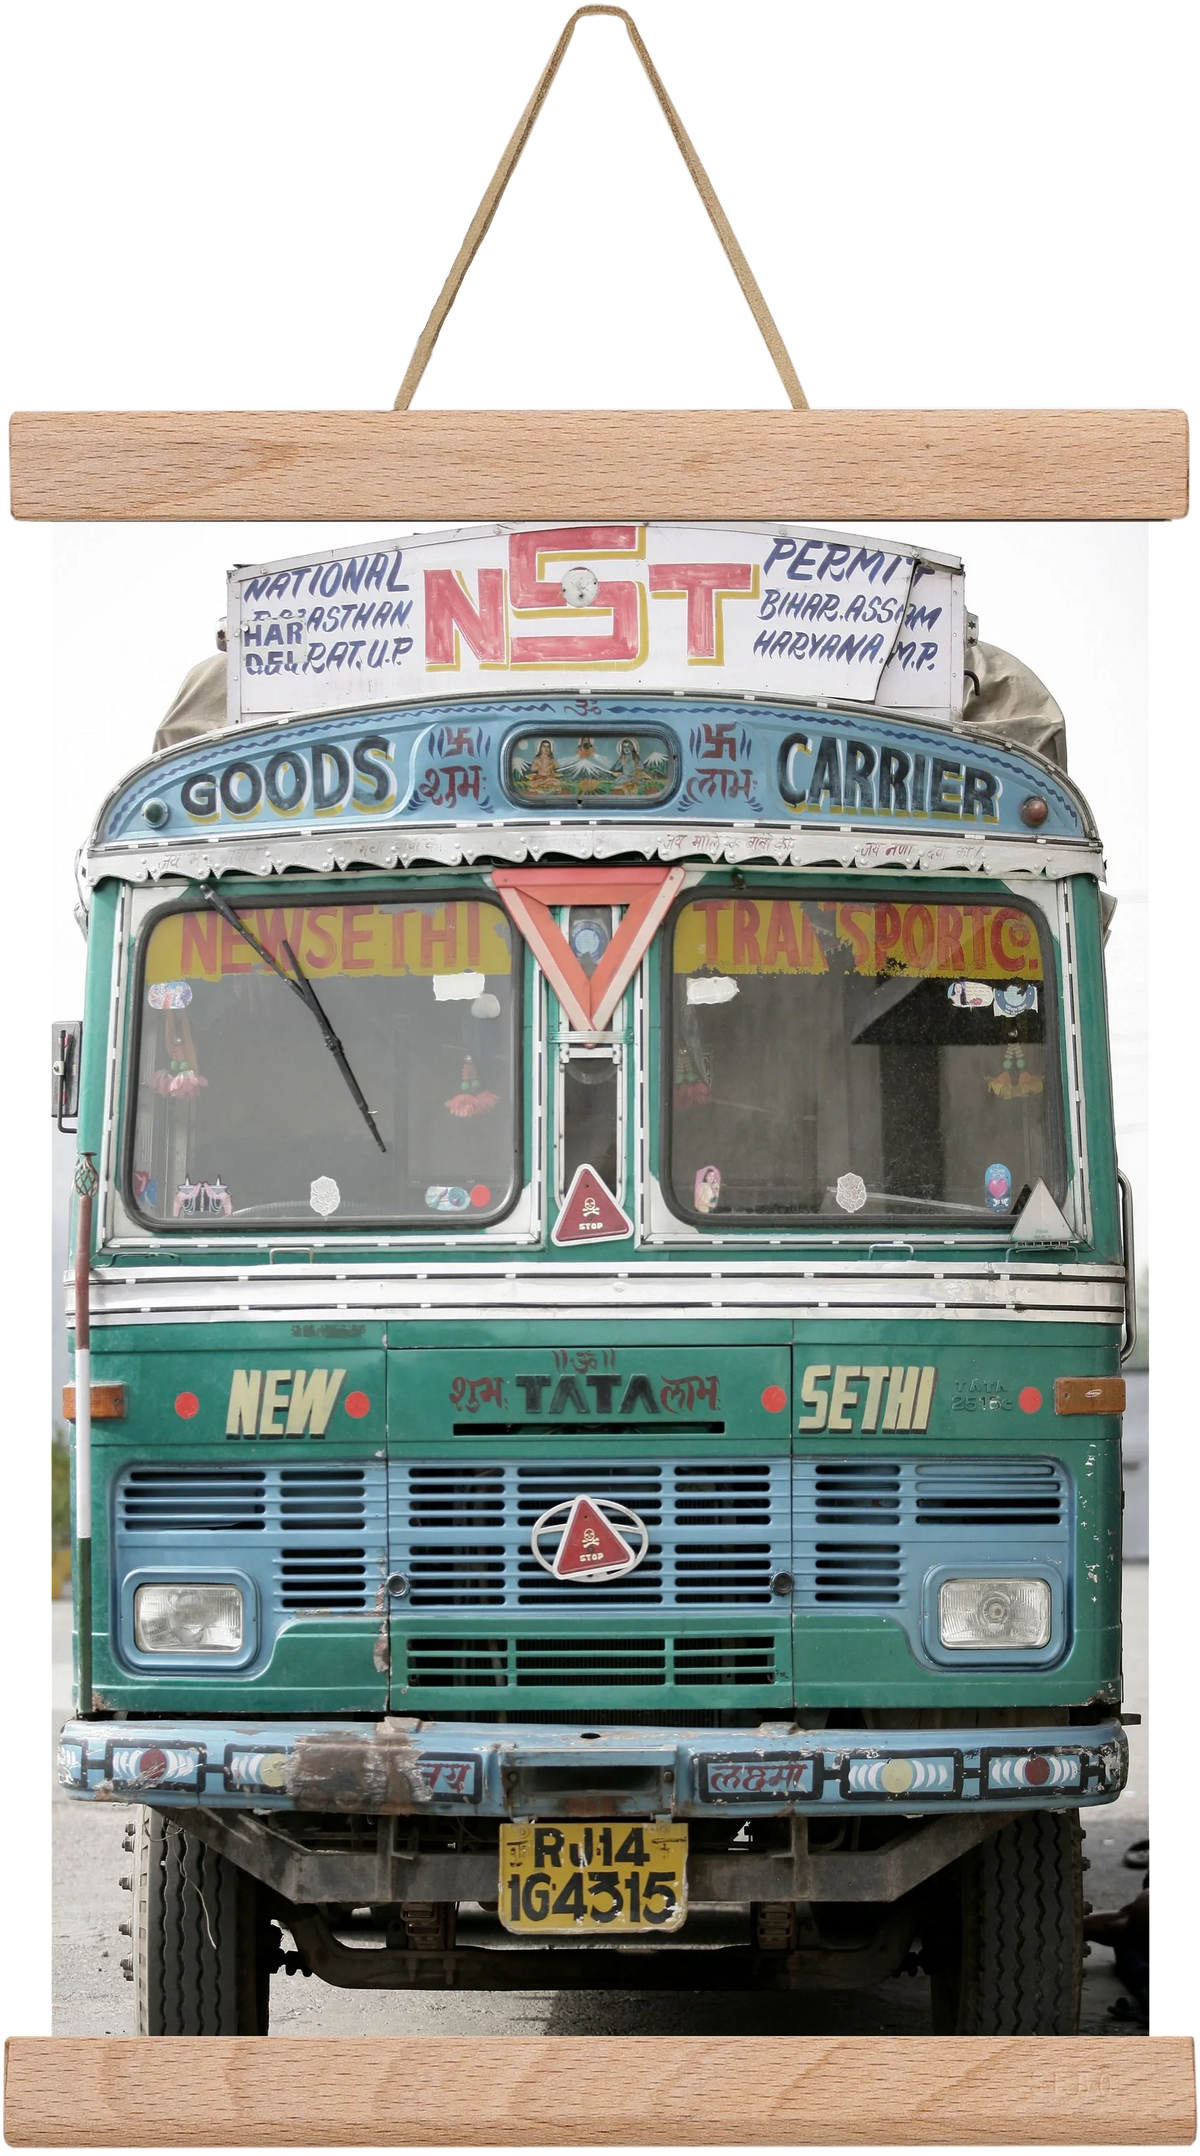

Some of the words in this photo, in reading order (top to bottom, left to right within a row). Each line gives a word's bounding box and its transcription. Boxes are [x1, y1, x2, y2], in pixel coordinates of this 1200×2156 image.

[243, 549, 410, 603] NATIONAL
[423, 526, 760, 672] NST
[181, 735, 397, 824] GOODS
[777, 732, 1004, 825] CARRIER
[578, 1222, 604, 1231] STOP
[226, 1368, 347, 1440] NEW
[515, 1373, 661, 1414] TATA
[798, 1364, 939, 1434] SETHI
[579, 1552, 605, 1562] STOP
